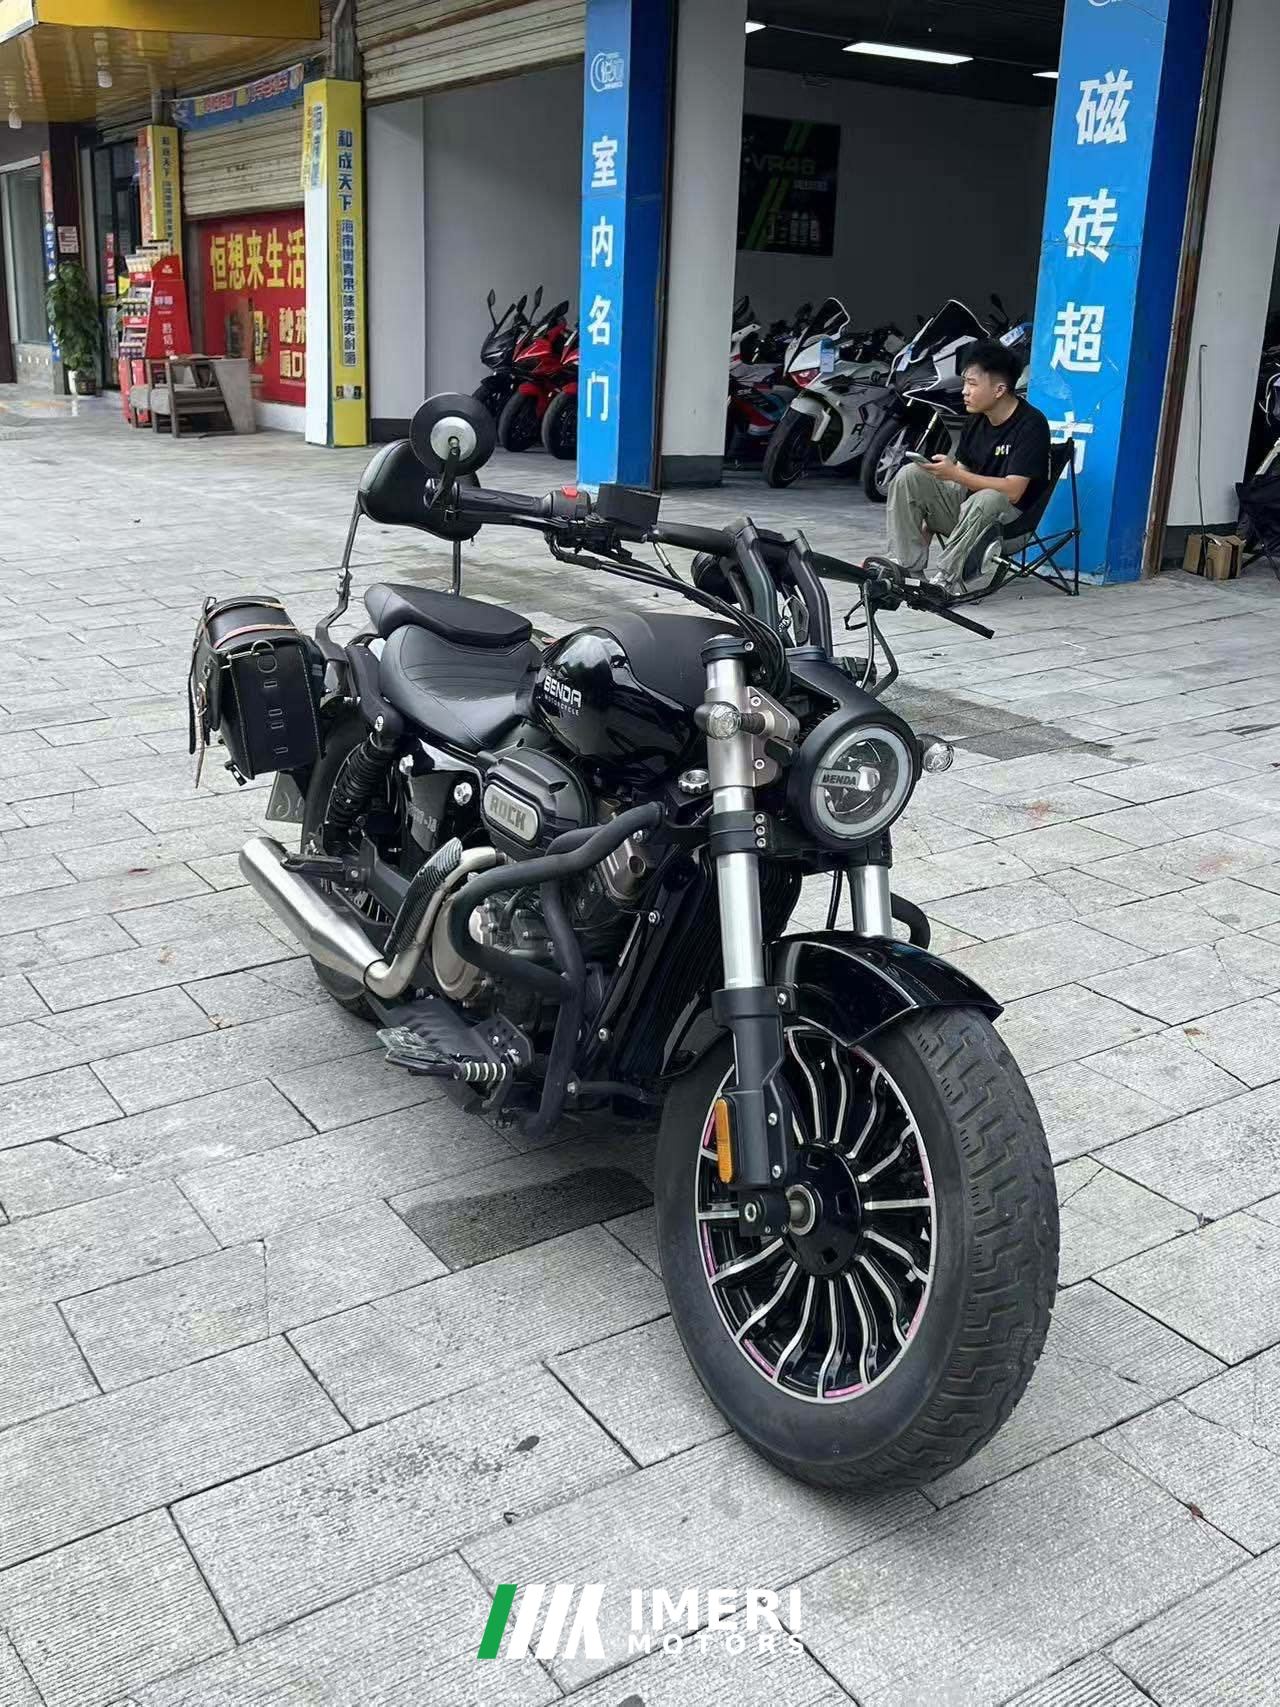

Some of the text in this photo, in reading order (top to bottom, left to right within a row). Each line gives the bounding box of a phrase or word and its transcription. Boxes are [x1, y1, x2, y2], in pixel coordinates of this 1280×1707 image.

[337, 129, 353, 211] 和成天下
[210, 228, 305, 292] 恒想来生活
[586, 136, 618, 421] 室内名门
[1048, 69, 1133, 480] 磁砖超市
[544, 675, 582, 708] BENDA
[822, 773, 857, 786] BENDA
[490, 794, 527, 832] ROCK
